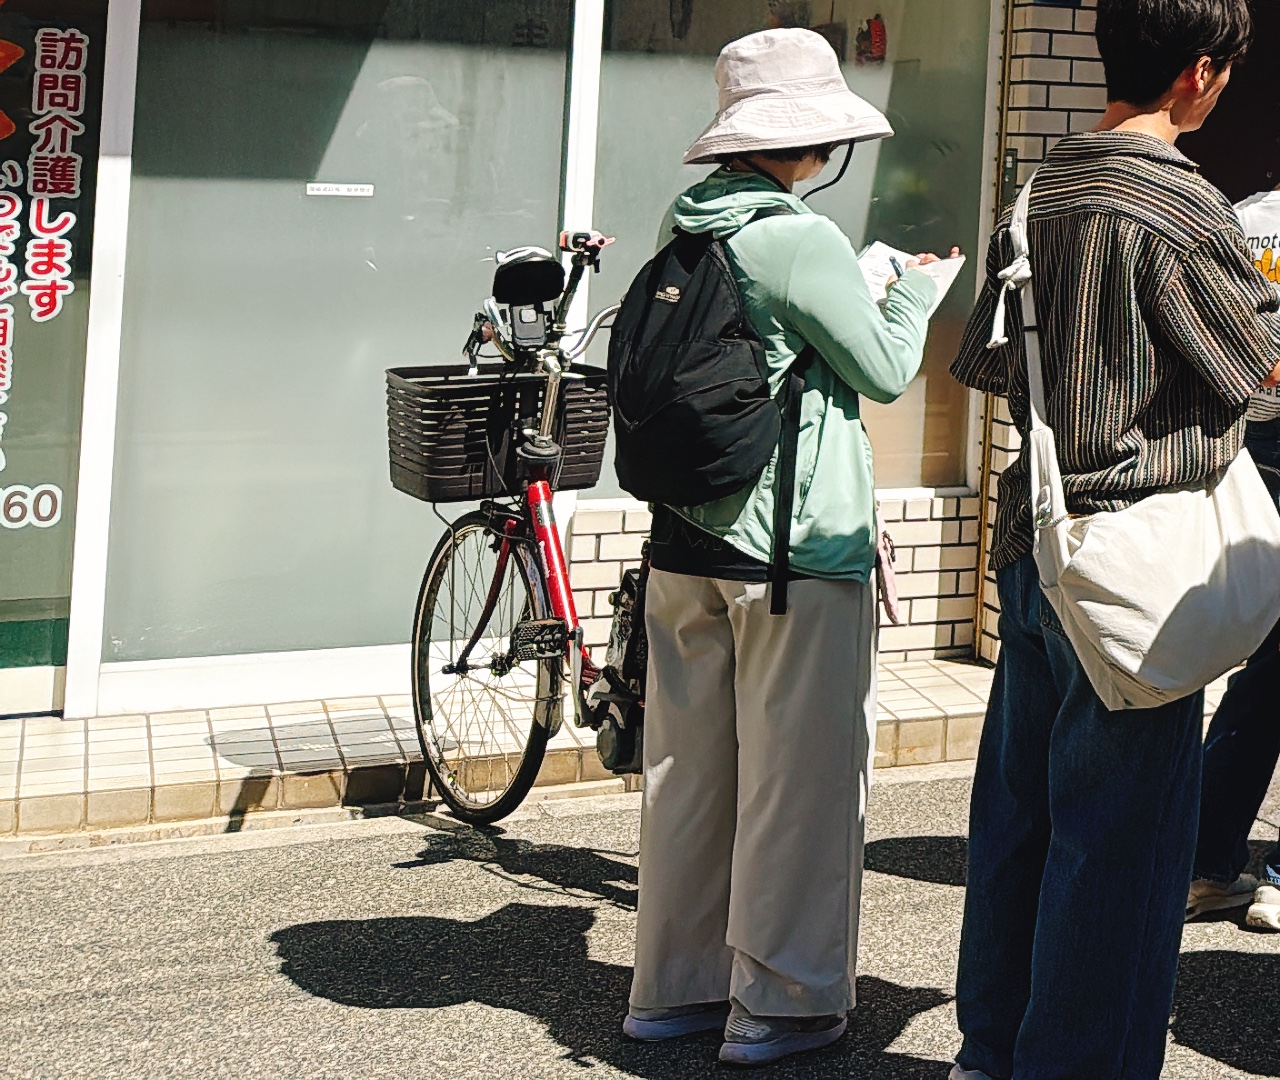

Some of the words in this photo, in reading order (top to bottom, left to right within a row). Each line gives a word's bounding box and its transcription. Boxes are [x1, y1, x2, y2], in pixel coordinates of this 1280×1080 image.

[25, 30, 85, 320] 訪問介護します
[0, 489, 58, 523] 60
